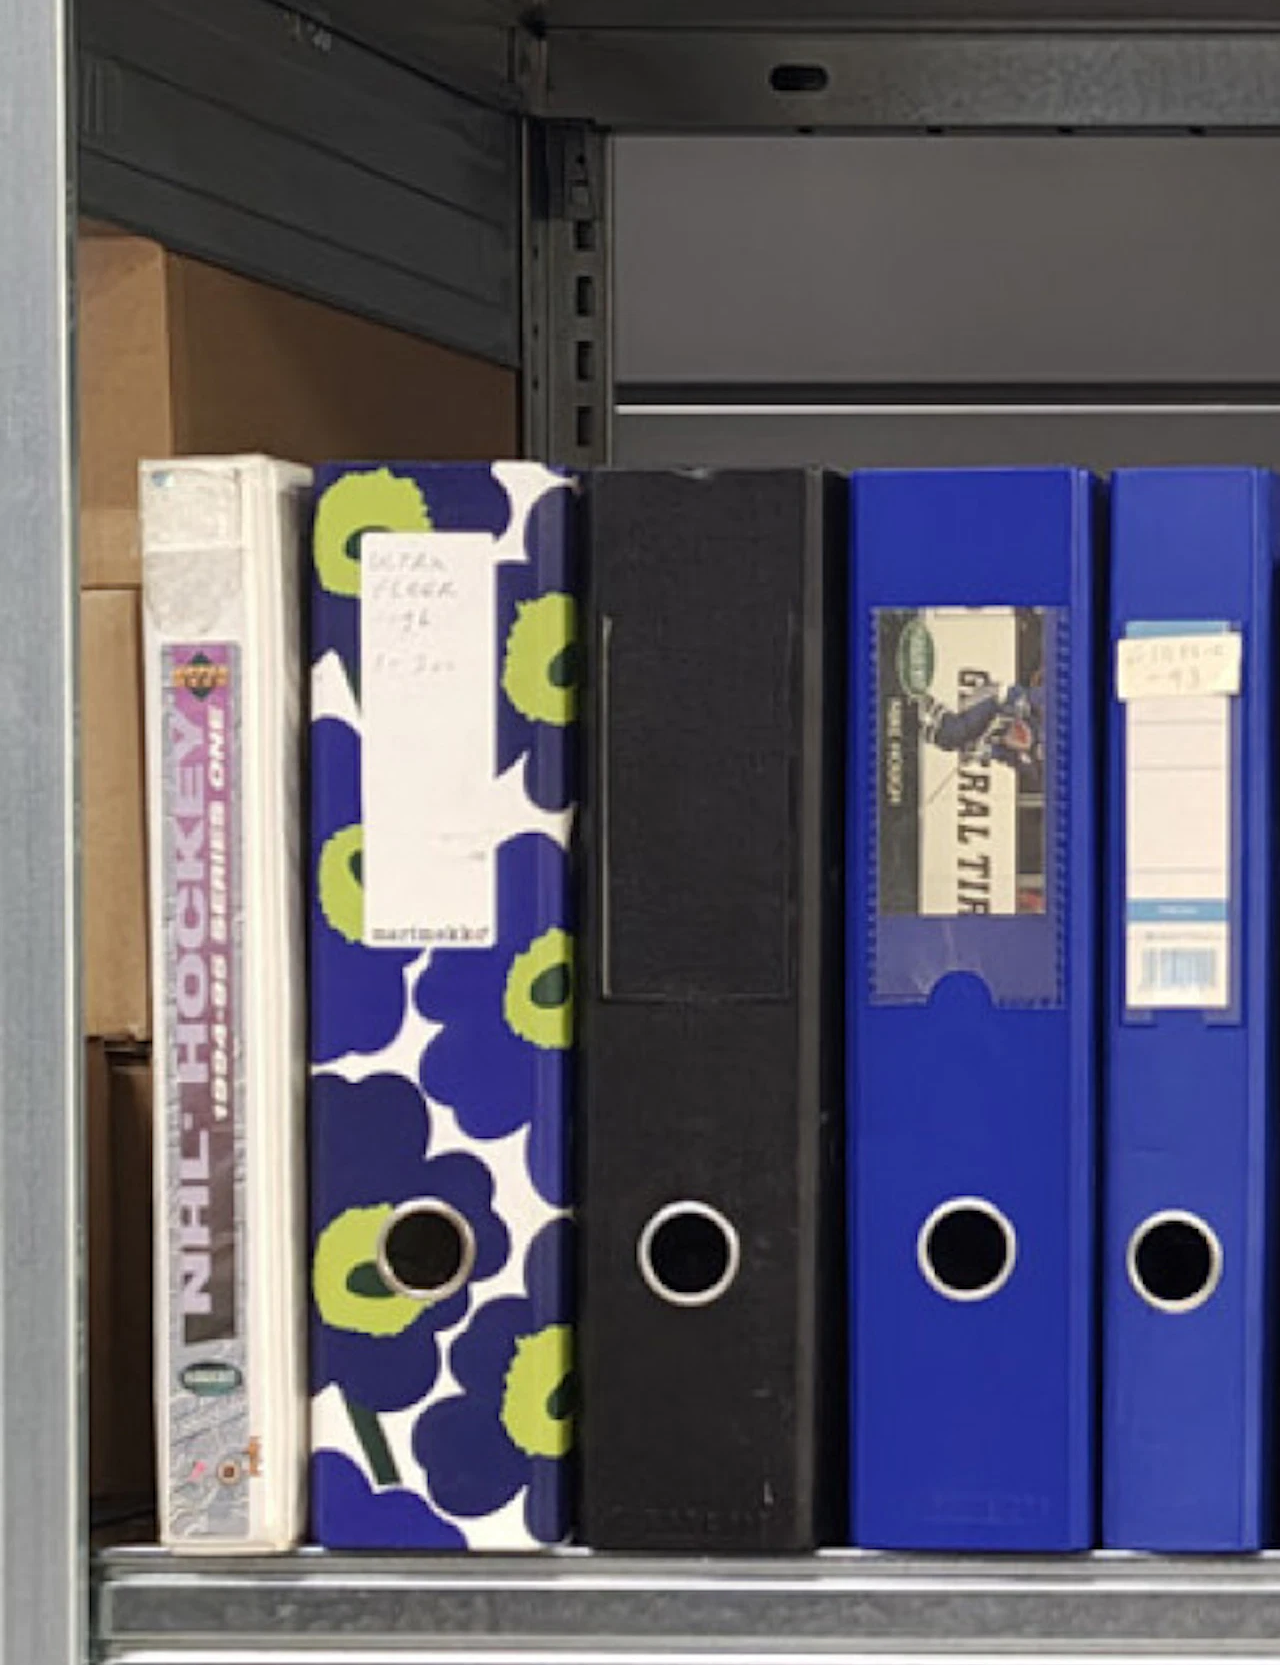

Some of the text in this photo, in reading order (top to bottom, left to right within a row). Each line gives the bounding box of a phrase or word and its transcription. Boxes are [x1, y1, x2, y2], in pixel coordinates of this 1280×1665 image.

[206, 705, 226, 791] ONE
[170, 703, 209, 1084] HOCKEY
[207, 802, 228, 944] SERIES
